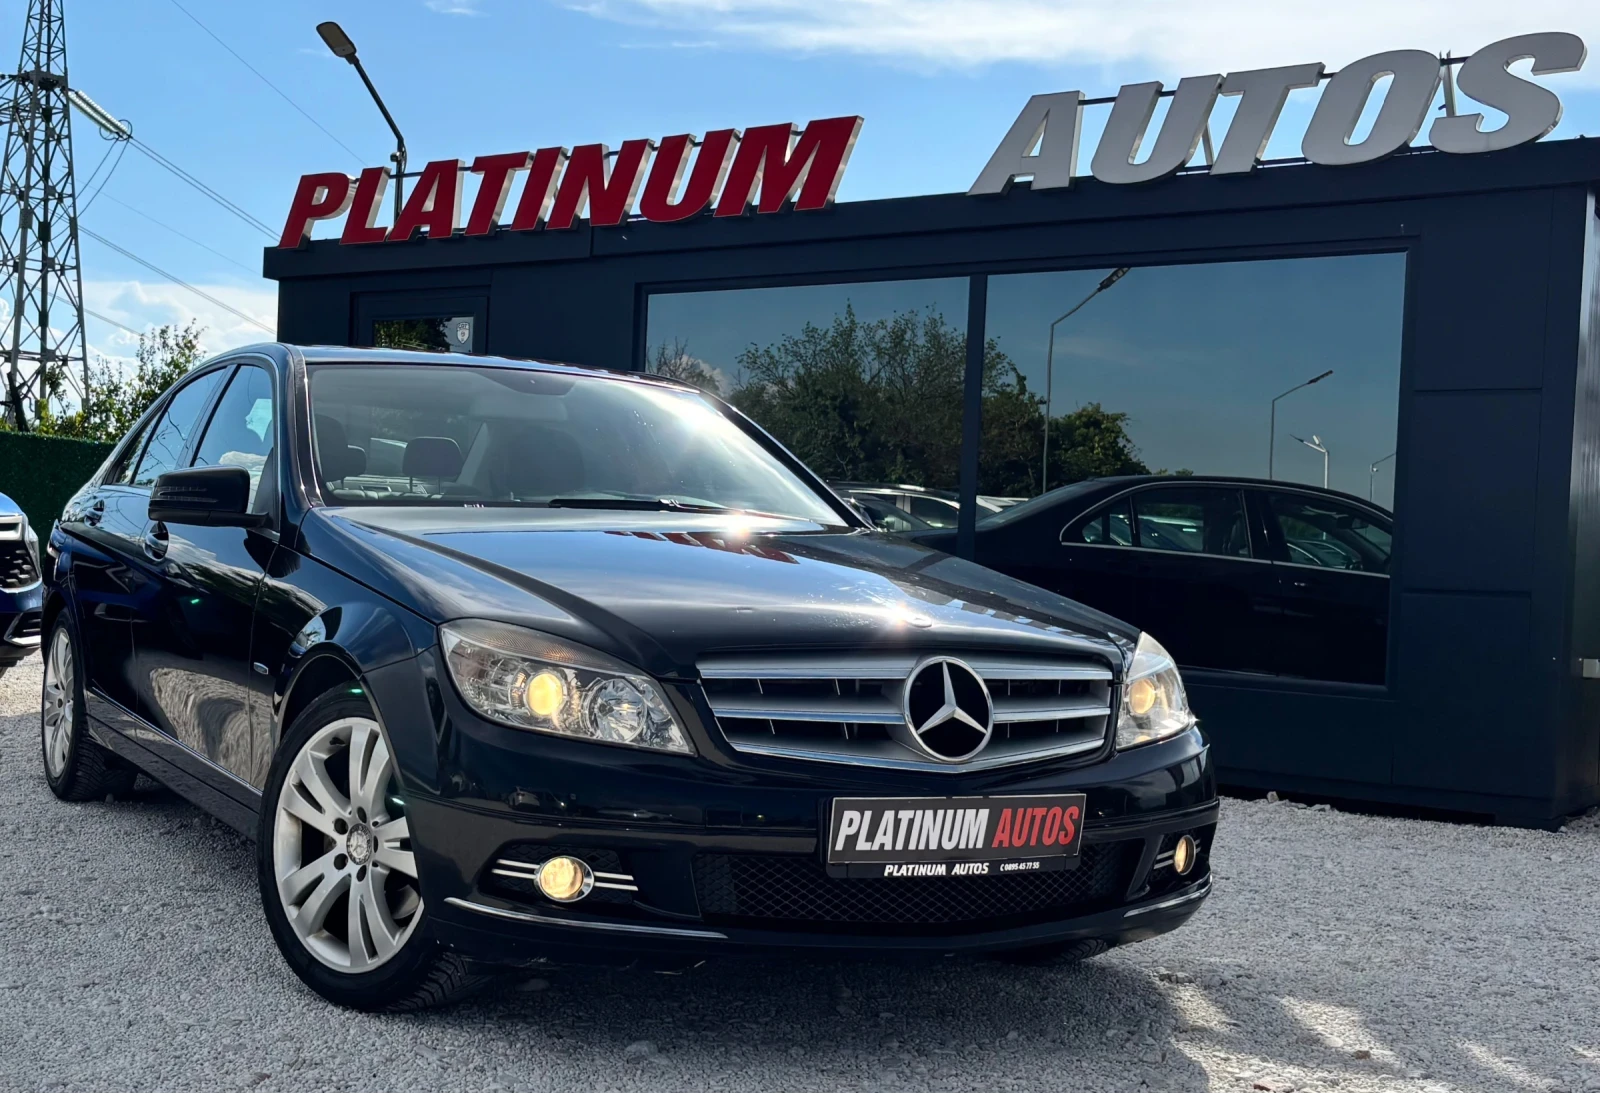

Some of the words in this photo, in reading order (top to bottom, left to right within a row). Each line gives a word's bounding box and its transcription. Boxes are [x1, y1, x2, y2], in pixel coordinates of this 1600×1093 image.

[279, 115, 864, 248] PLATINUM
[967, 32, 1587, 196] AUTOS
[835, 808, 990, 851] PLATINUM
[991, 806, 1080, 848] AUTOS
[884, 863, 946, 876] PLATINUM
[951, 862, 989, 875] AUTOS
